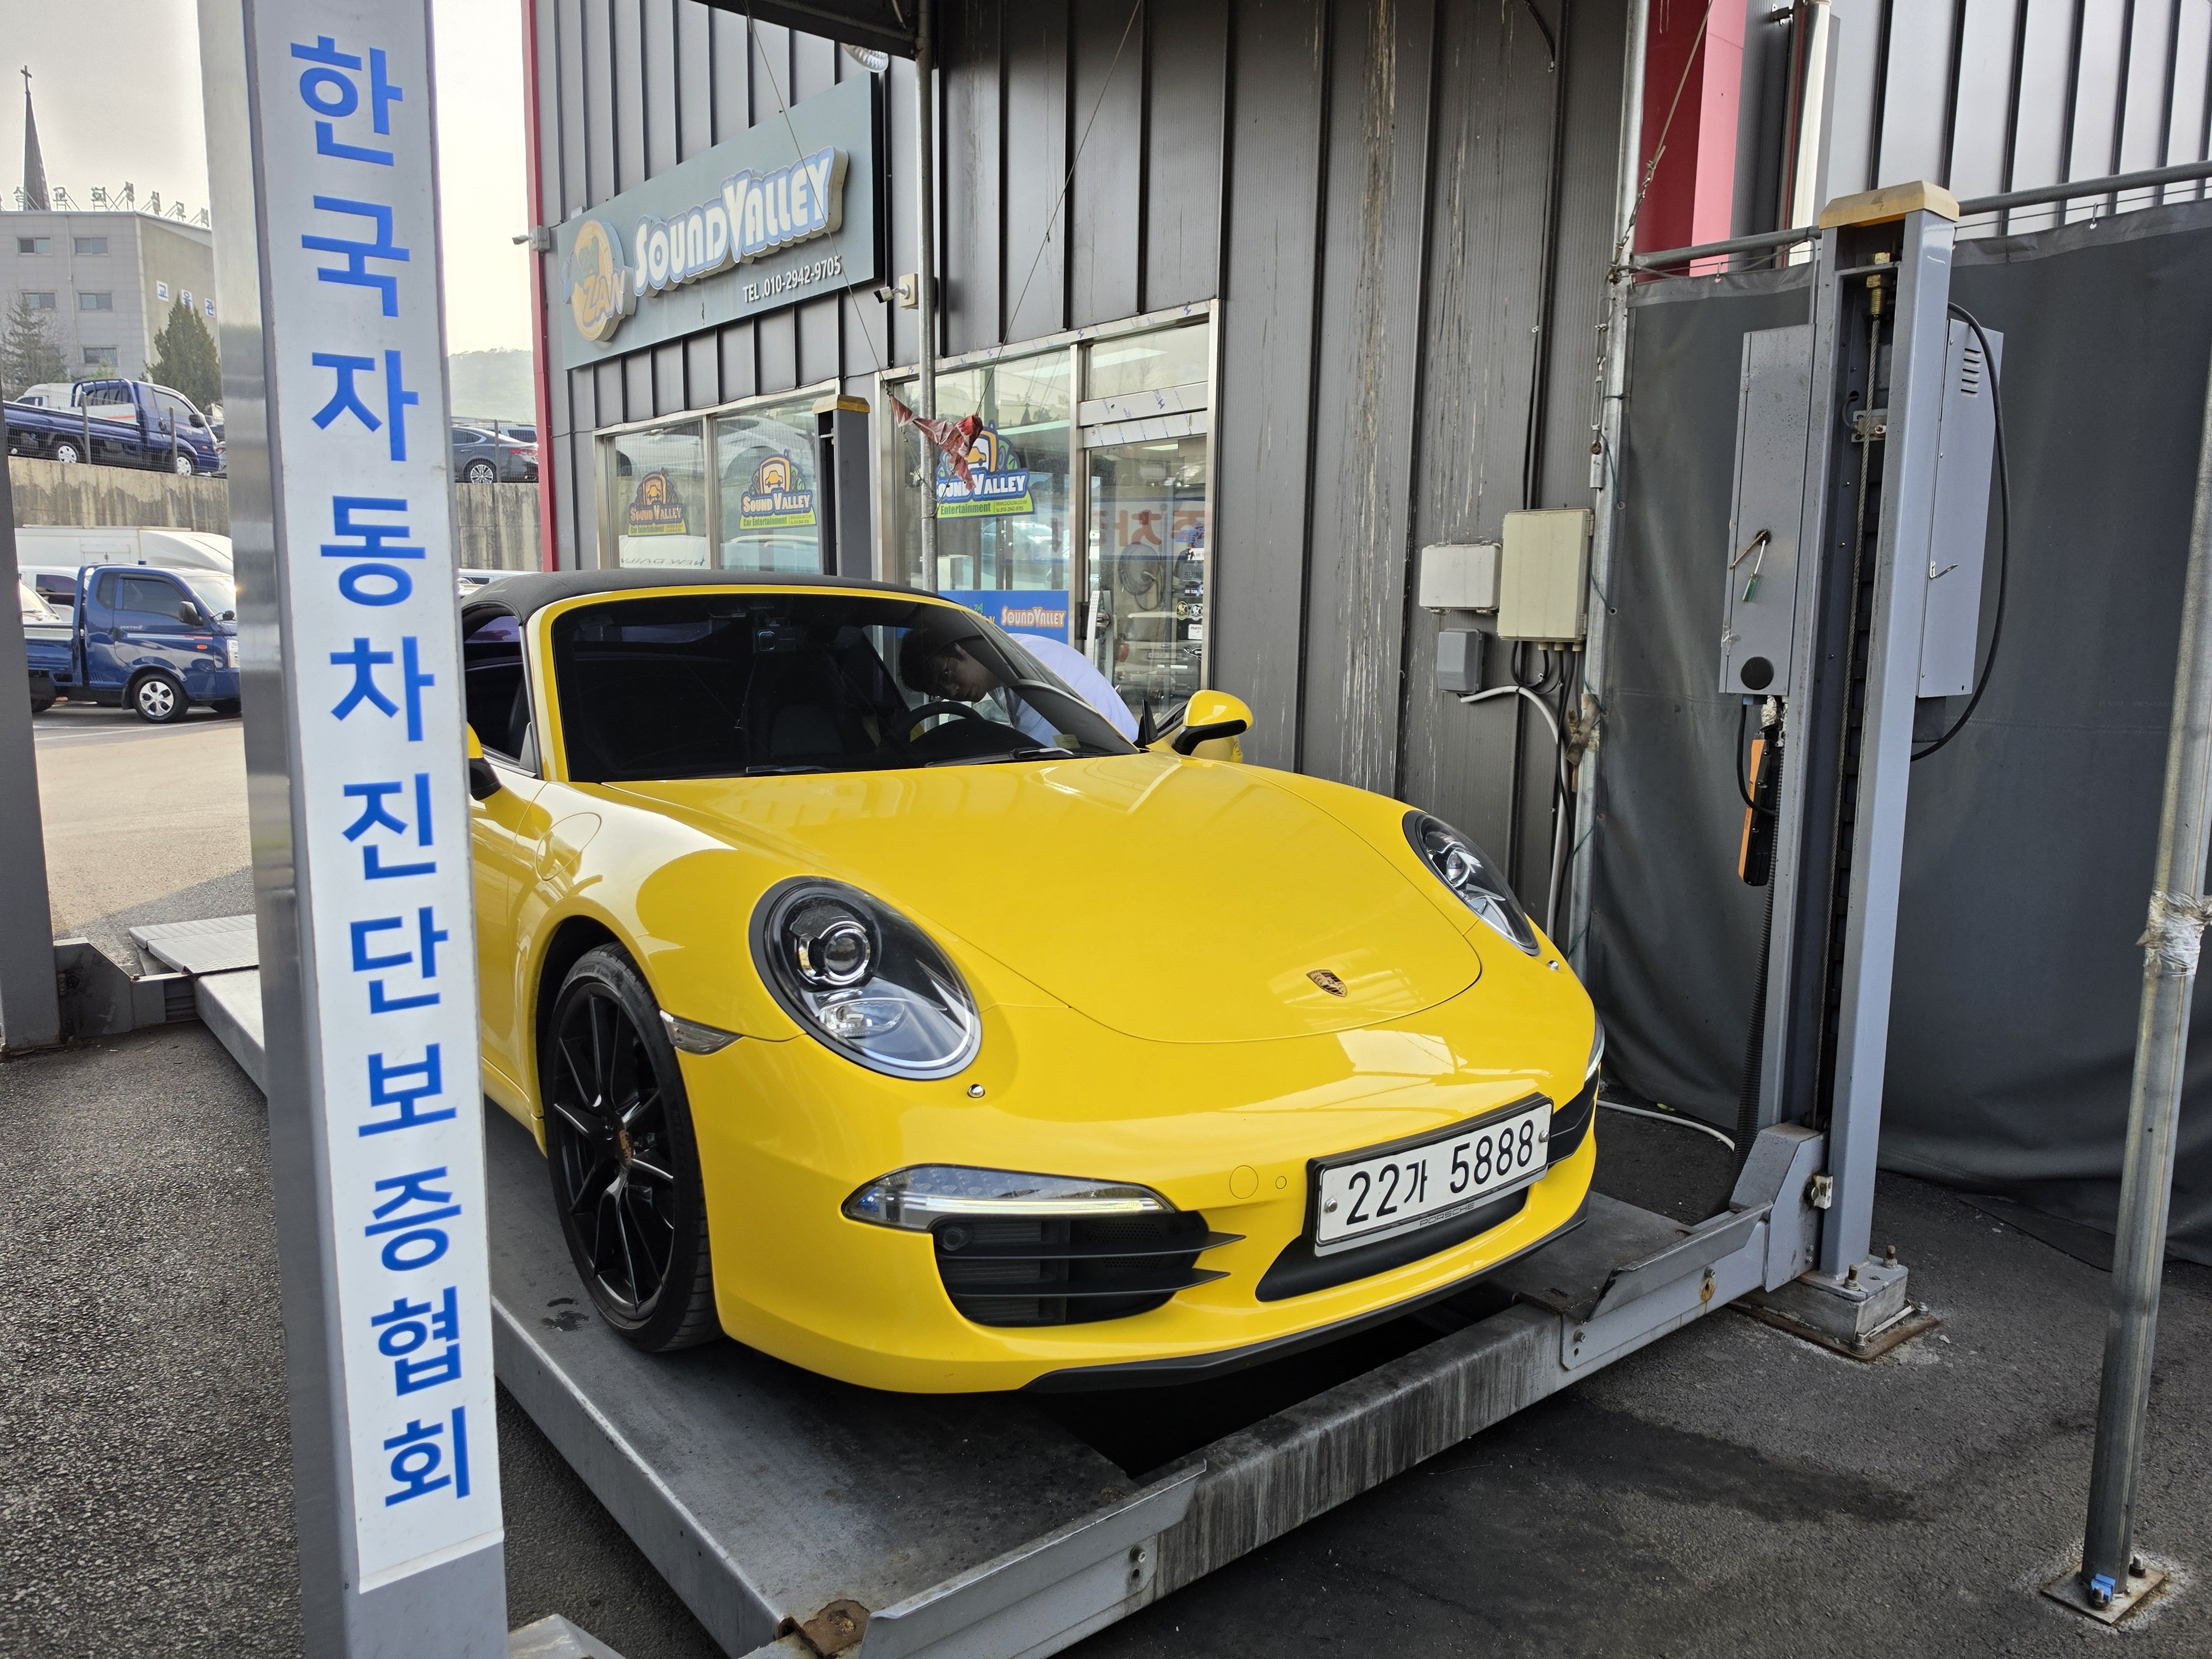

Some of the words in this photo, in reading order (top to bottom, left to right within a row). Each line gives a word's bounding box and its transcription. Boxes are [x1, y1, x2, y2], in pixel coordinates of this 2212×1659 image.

[743, 283, 759, 302] TEL
[937, 481, 970, 498] OUND
[972, 473, 1026, 495] VALLEY
[743, 496, 773, 513] SOUND
[773, 492, 810, 510] VALLEY
[941, 503, 991, 515] Entertainment
[743, 518, 752, 526] Car
[753, 517, 787, 526] Entertainment
[290, 35, 471, 1508] 한국자동차진단보증협회
[1346, 1159, 1428, 1225] 22가
[1449, 1119, 1534, 1193] 5888
[1420, 1202, 1475, 1227] PORSCHE
